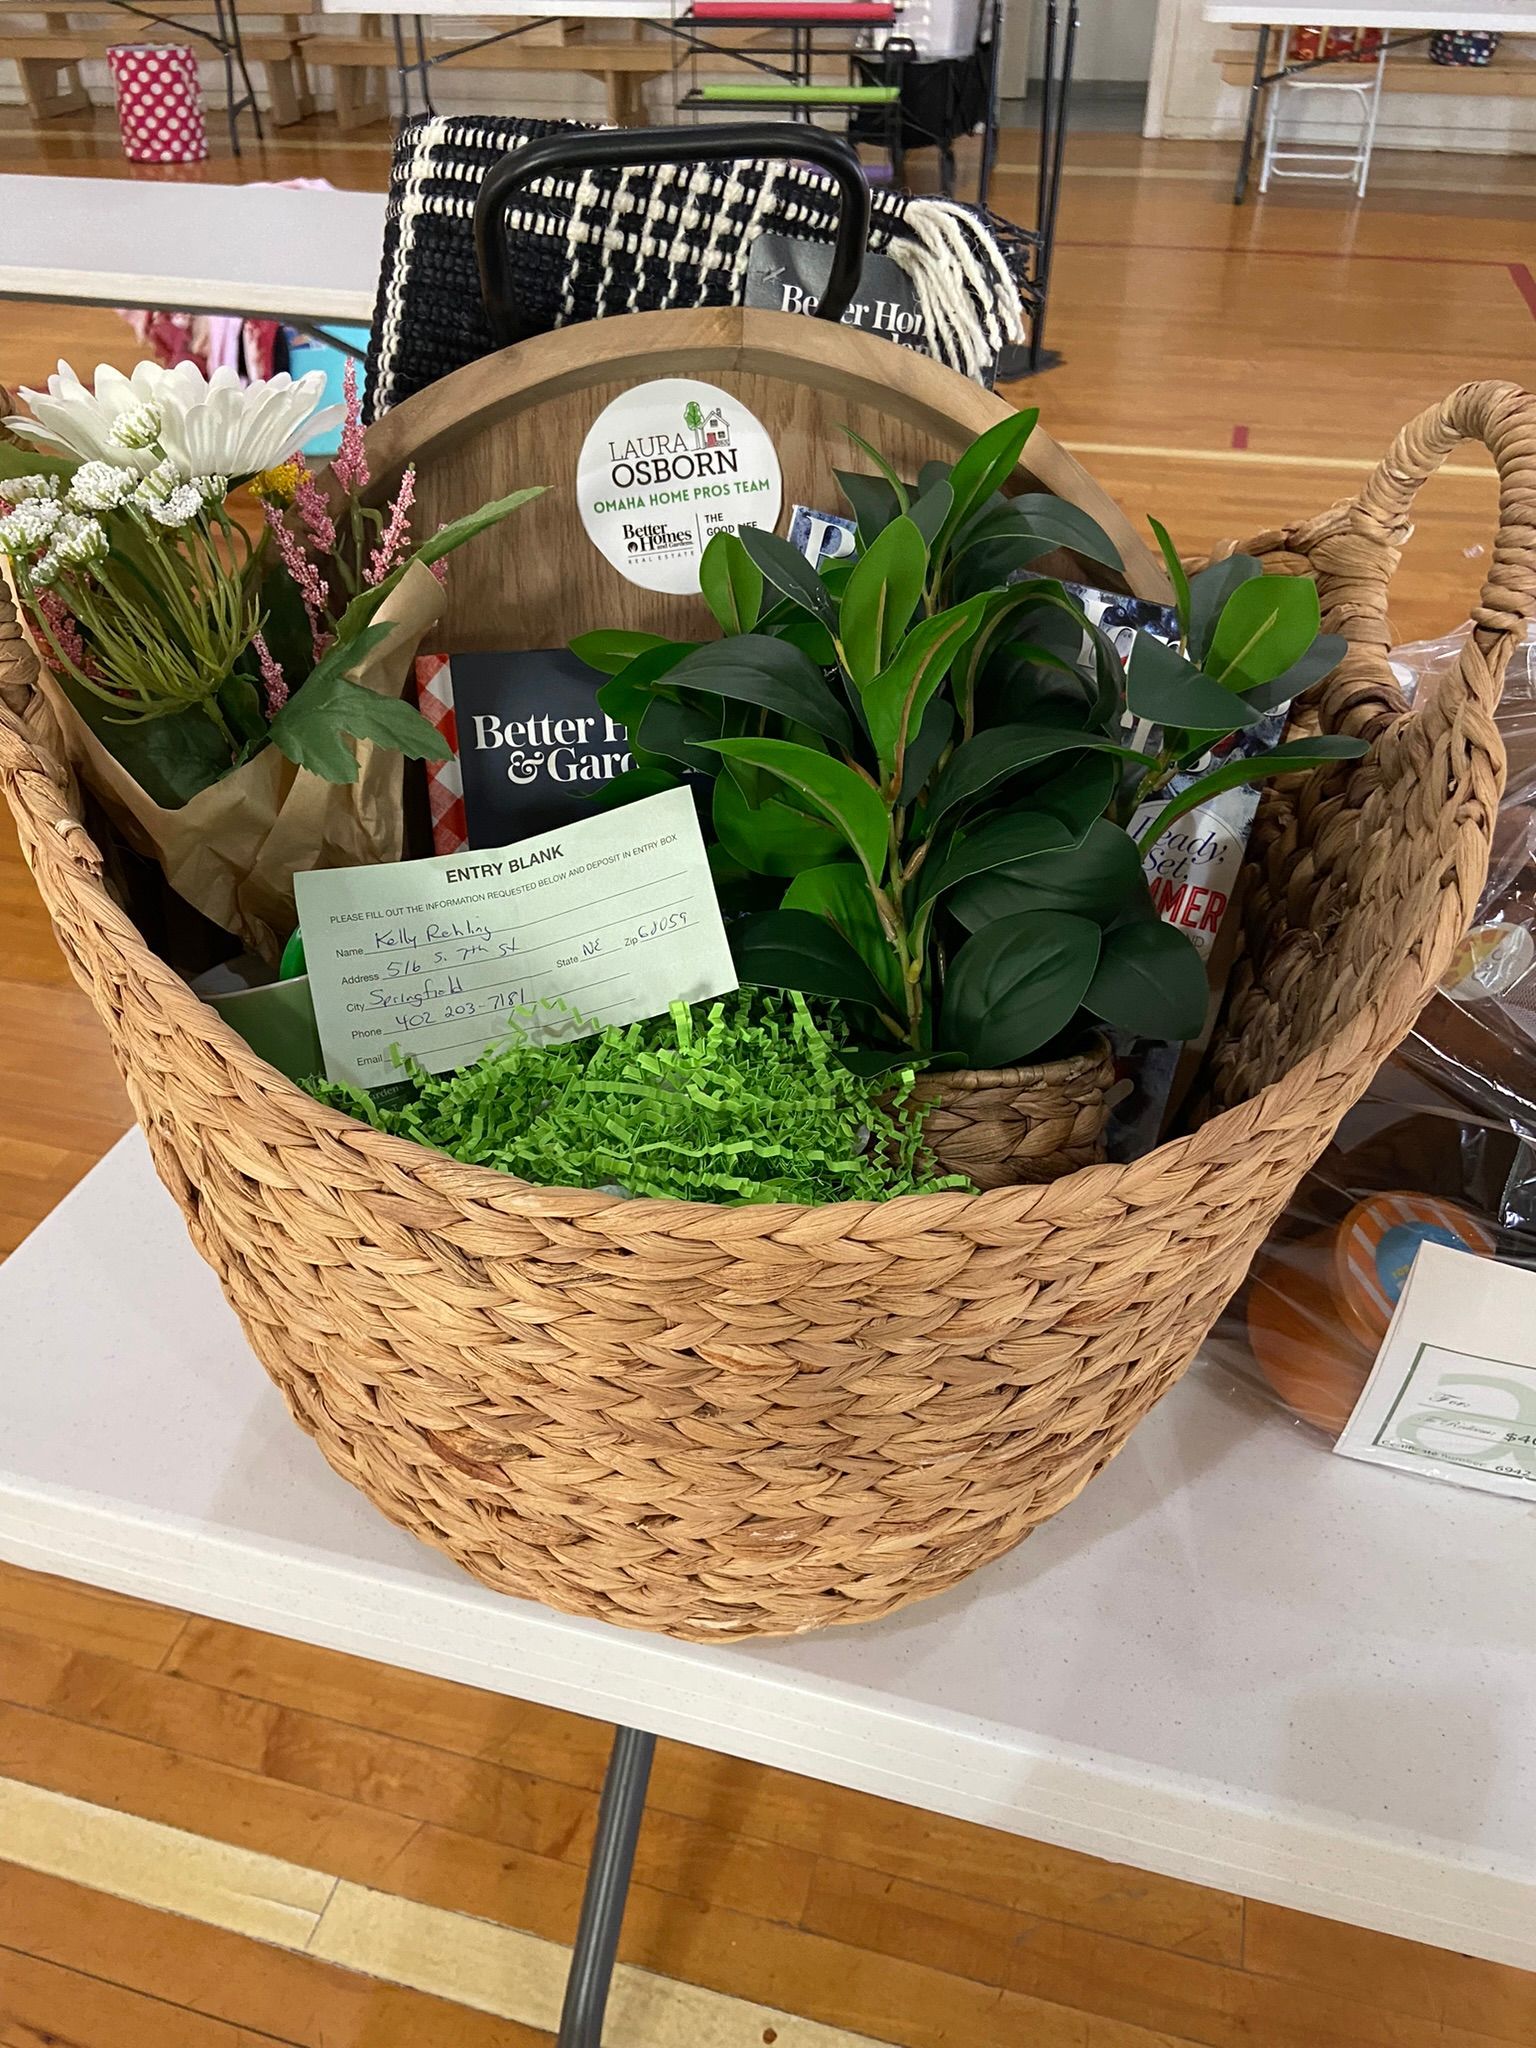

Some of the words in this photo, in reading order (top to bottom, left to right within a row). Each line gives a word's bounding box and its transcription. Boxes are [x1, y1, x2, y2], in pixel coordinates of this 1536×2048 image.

[781, 284, 869, 326] Beer
[609, 433, 688, 462] LAURA
[612, 449, 739, 488] OSBORN
[594, 496, 646, 514] OMAHA
[650, 490, 690, 507] HOME
[694, 484, 731, 500] PROS
[734, 479, 770, 494] TEAM
[704, 513, 724, 524] THE
[622, 524, 667, 539] Better
[640, 530, 692, 552] Homes
[658, 551, 694, 561] ESTATE
[472, 714, 594, 750] Better
[446, 862, 503, 883] ENTRY
[508, 844, 564, 873] BLANK
[1141, 848, 1188, 882] Set,
[330, 913, 364, 924] PLEASE
[366, 911, 385, 920] FILL
[386, 907, 403, 918] OUT
[406, 904, 424, 914] THE
[426, 894, 486, 911] INFORMATION
[487, 882, 537, 900] REQUESTED
[538, 872, 567, 888] BELOW
[568, 866, 585, 877] AND
[587, 854, 621, 872] DEPOSIT
[622, 851, 632, 860] IN
[633, 841, 659, 856] ENTRY
[660, 834, 678, 846] BOX
[375, 927, 417, 949] Kelly
[582, 938, 602, 956] NE
[624, 937, 638, 947] Zip
[336, 948, 364, 958] Name
[556, 956, 579, 968] State
[341, 973, 380, 985] Address
[369, 975, 463, 1008] Springfield
[346, 1003, 365, 1014] City
[395, 1011, 437, 1030] 402
[351, 1027, 382, 1040] Phone
[357, 1055, 383, 1067] Email
